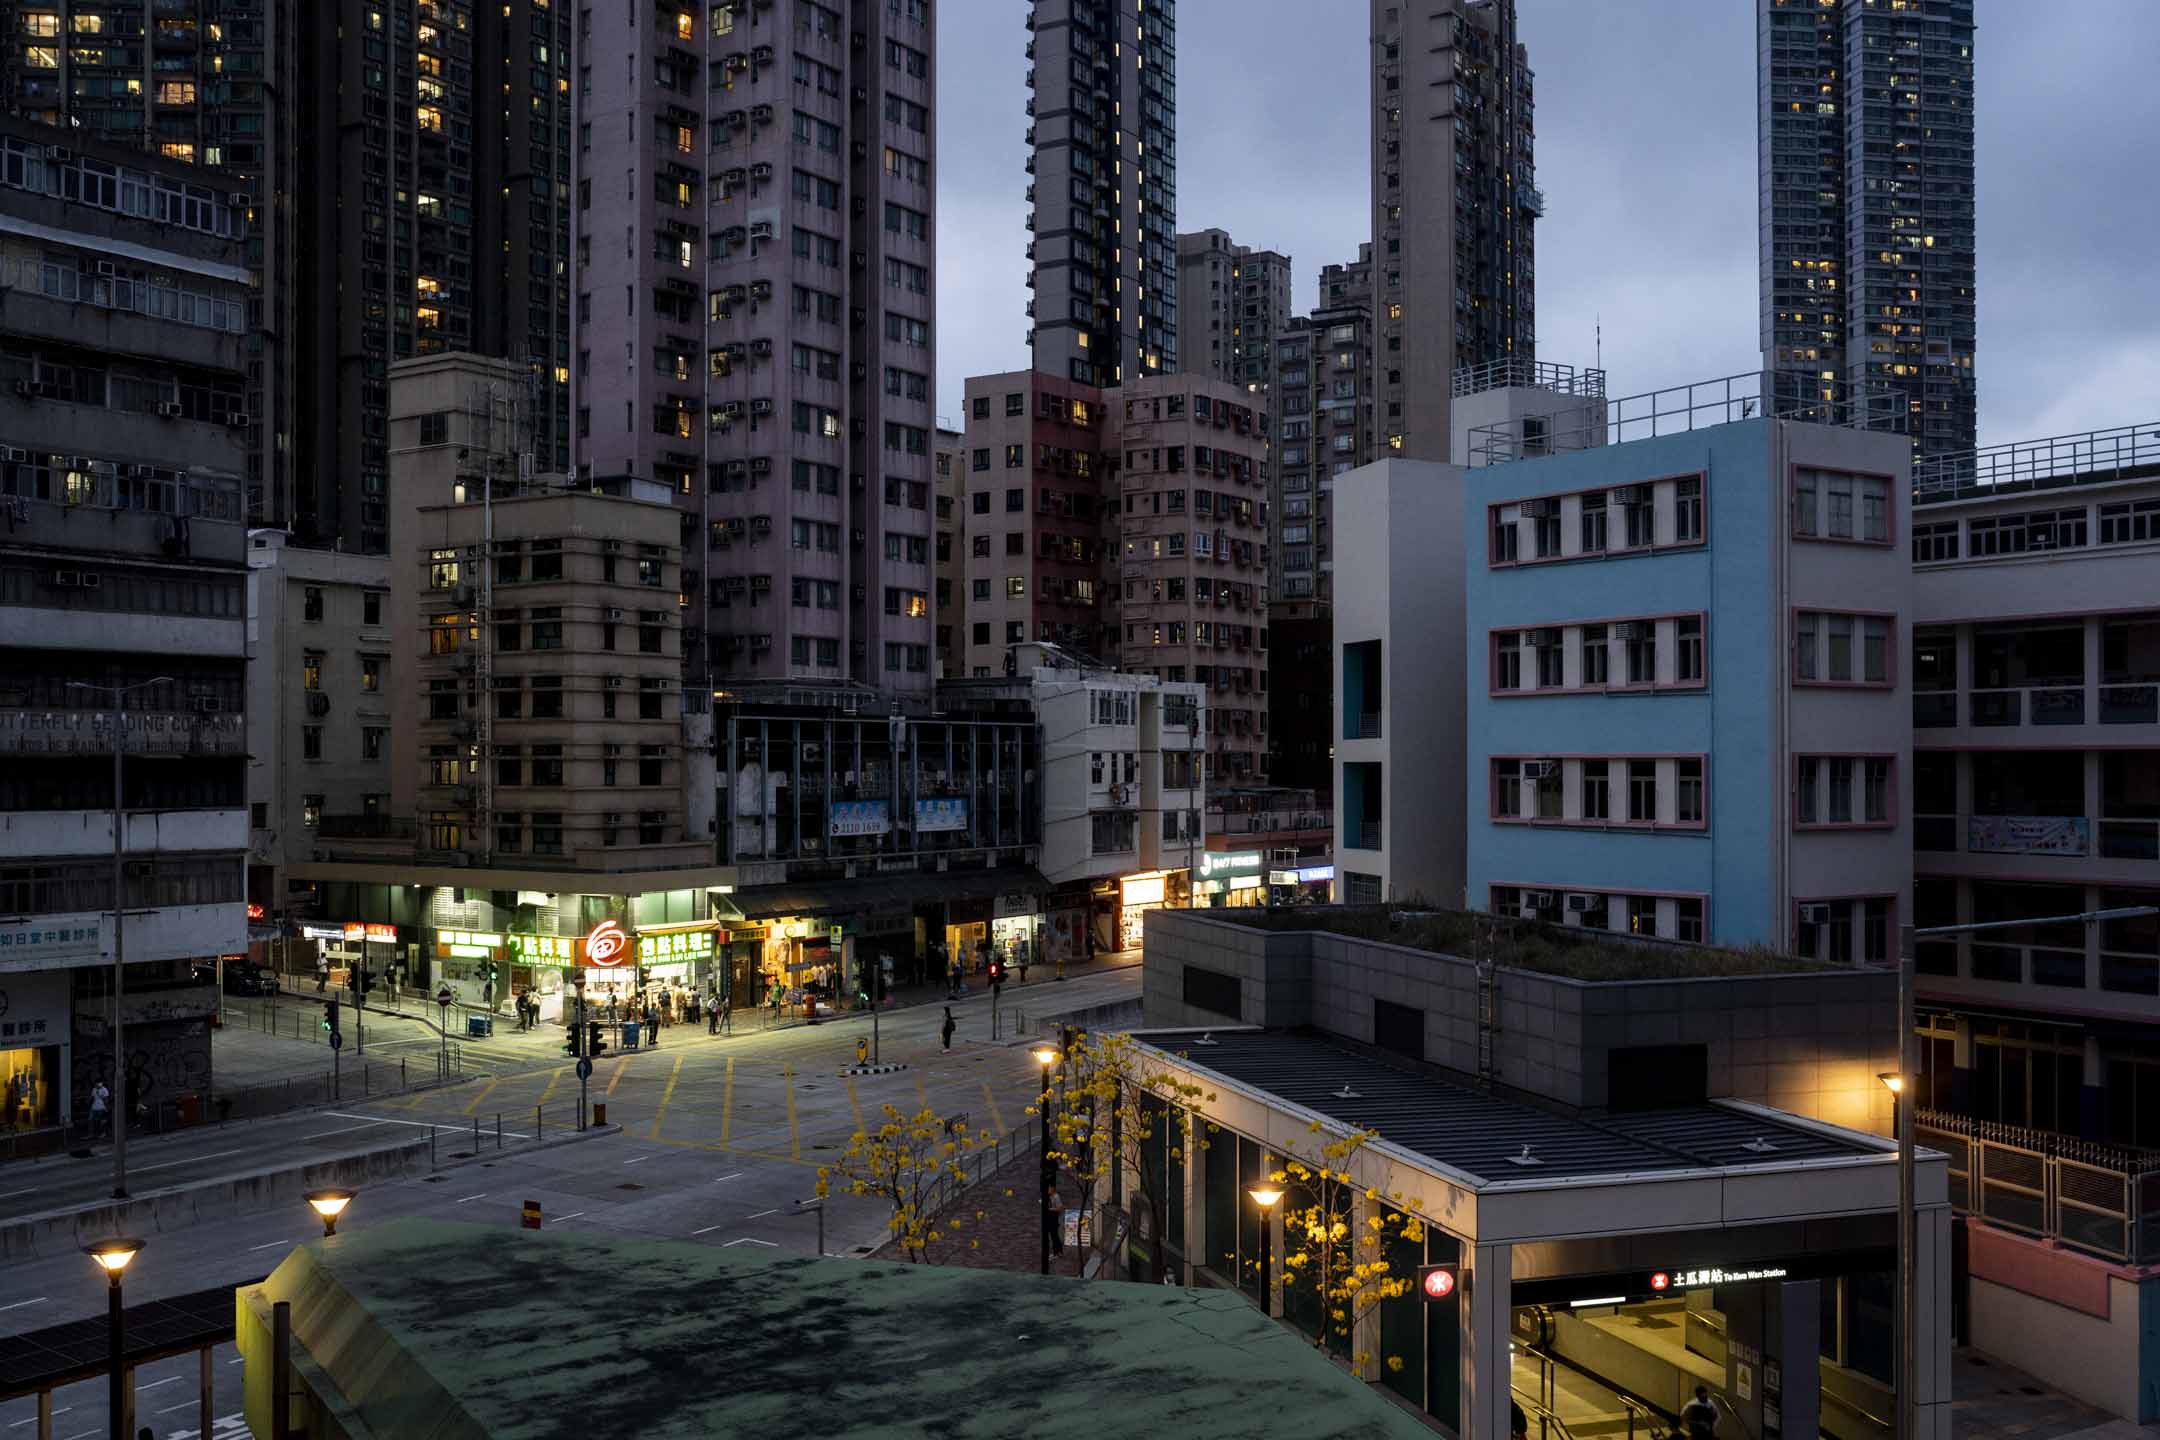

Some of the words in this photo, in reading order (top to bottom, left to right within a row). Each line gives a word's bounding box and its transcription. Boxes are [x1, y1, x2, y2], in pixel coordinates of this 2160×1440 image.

[1673, 1269, 1723, 1286] 土瓜灣站
[1724, 1273, 1733, 1282] To
[1733, 1272, 1747, 1281] Kwa
[1748, 1270, 1763, 1280] Wan
[1763, 1269, 1786, 1278] Station
